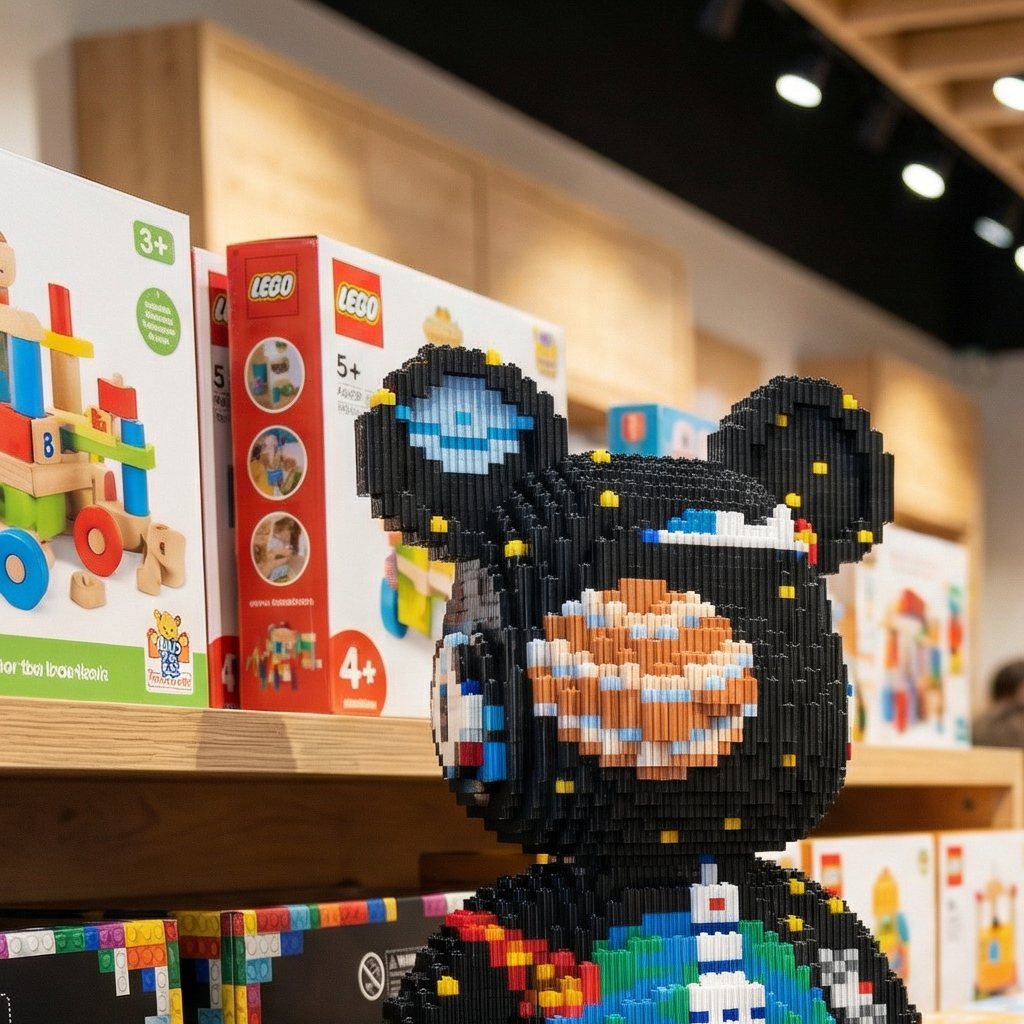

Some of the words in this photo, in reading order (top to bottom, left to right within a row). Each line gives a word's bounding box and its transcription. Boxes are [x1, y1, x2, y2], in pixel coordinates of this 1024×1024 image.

[139, 226, 168, 256] 3+
[249, 272, 296, 301] LEGO
[336, 282, 381, 325] LEGO
[336, 353, 361, 381] 5+
[338, 646, 377, 690] 4+
